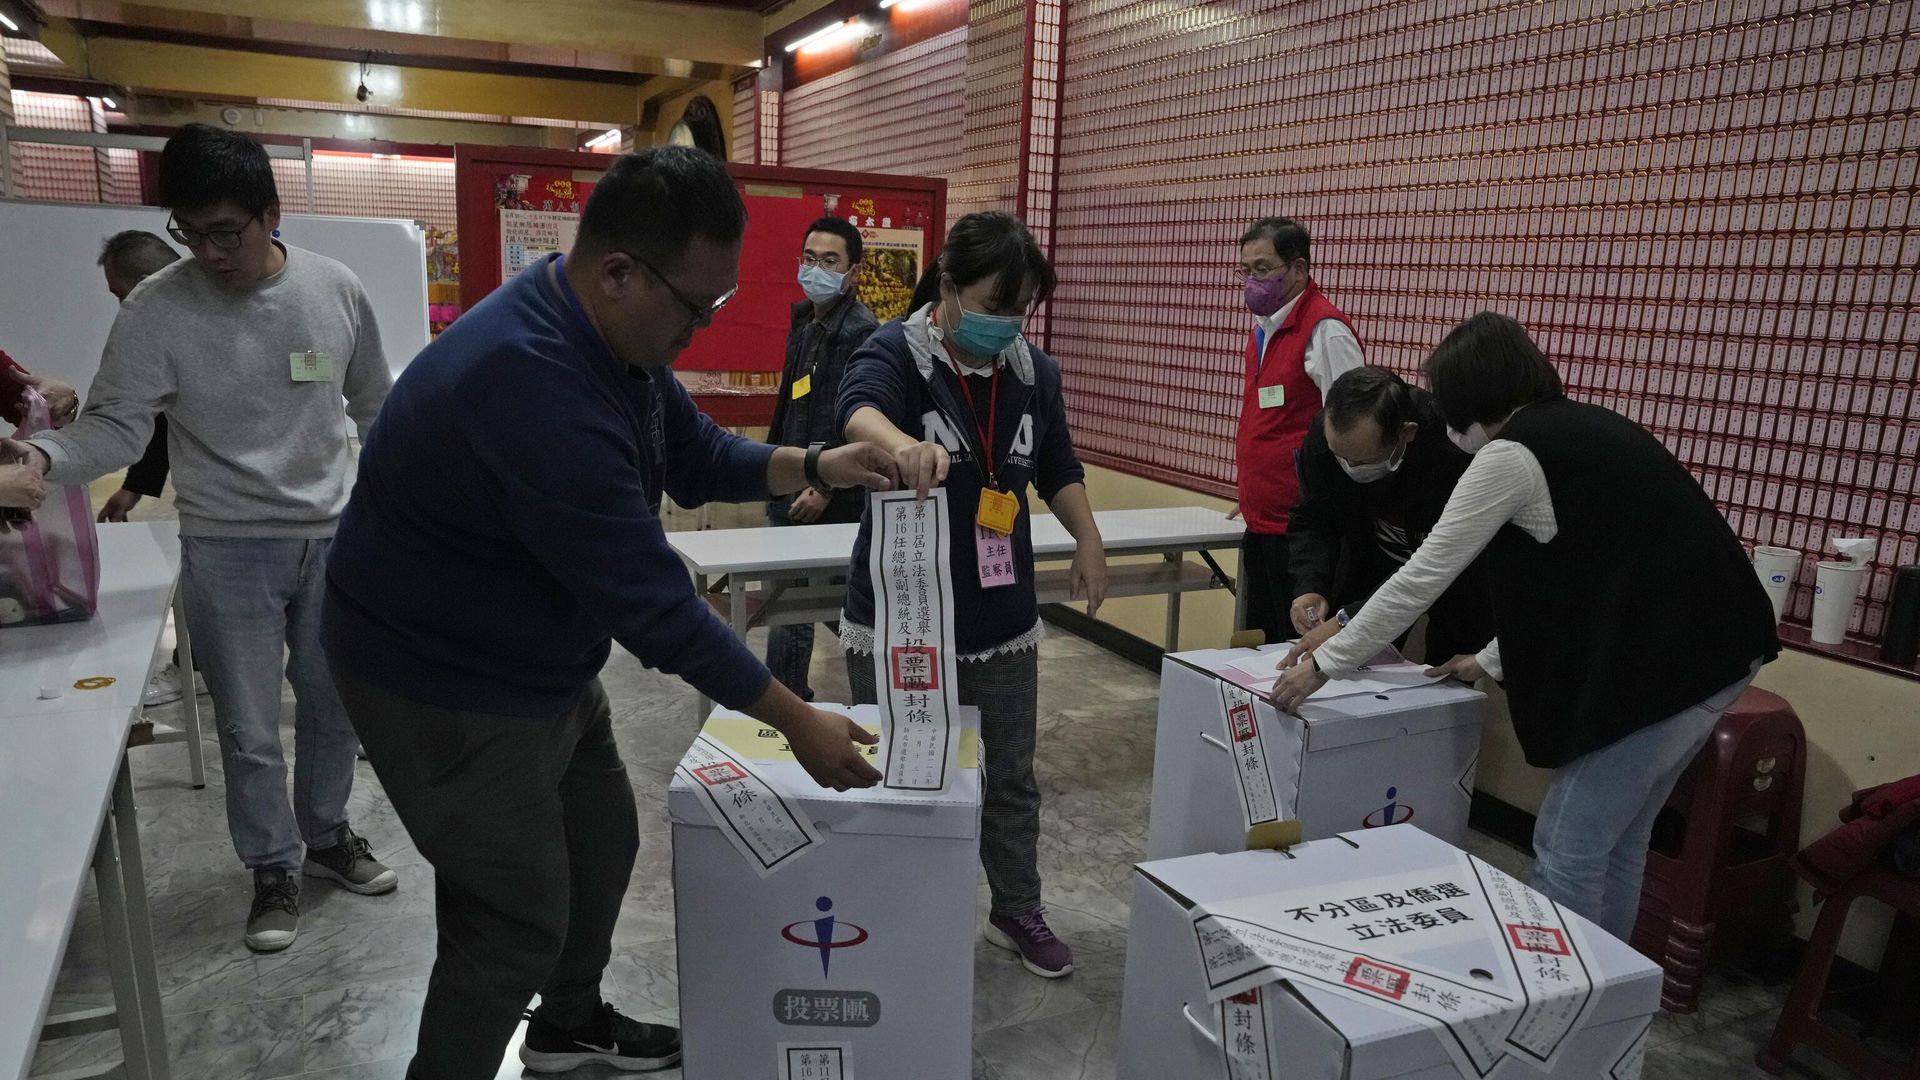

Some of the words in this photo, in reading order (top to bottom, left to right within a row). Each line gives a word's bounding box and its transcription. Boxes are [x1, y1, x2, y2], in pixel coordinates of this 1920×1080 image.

[912, 504, 932, 636] 第11屆立法委員選舉
[981, 560, 1013, 579] 監察員
[986, 544, 1007, 558] 主任
[891, 506, 912, 635] 第16任總統副總統及
[1284, 882, 1470, 923] 不分區及僑選
[1347, 906, 1474, 941] 立法委員
